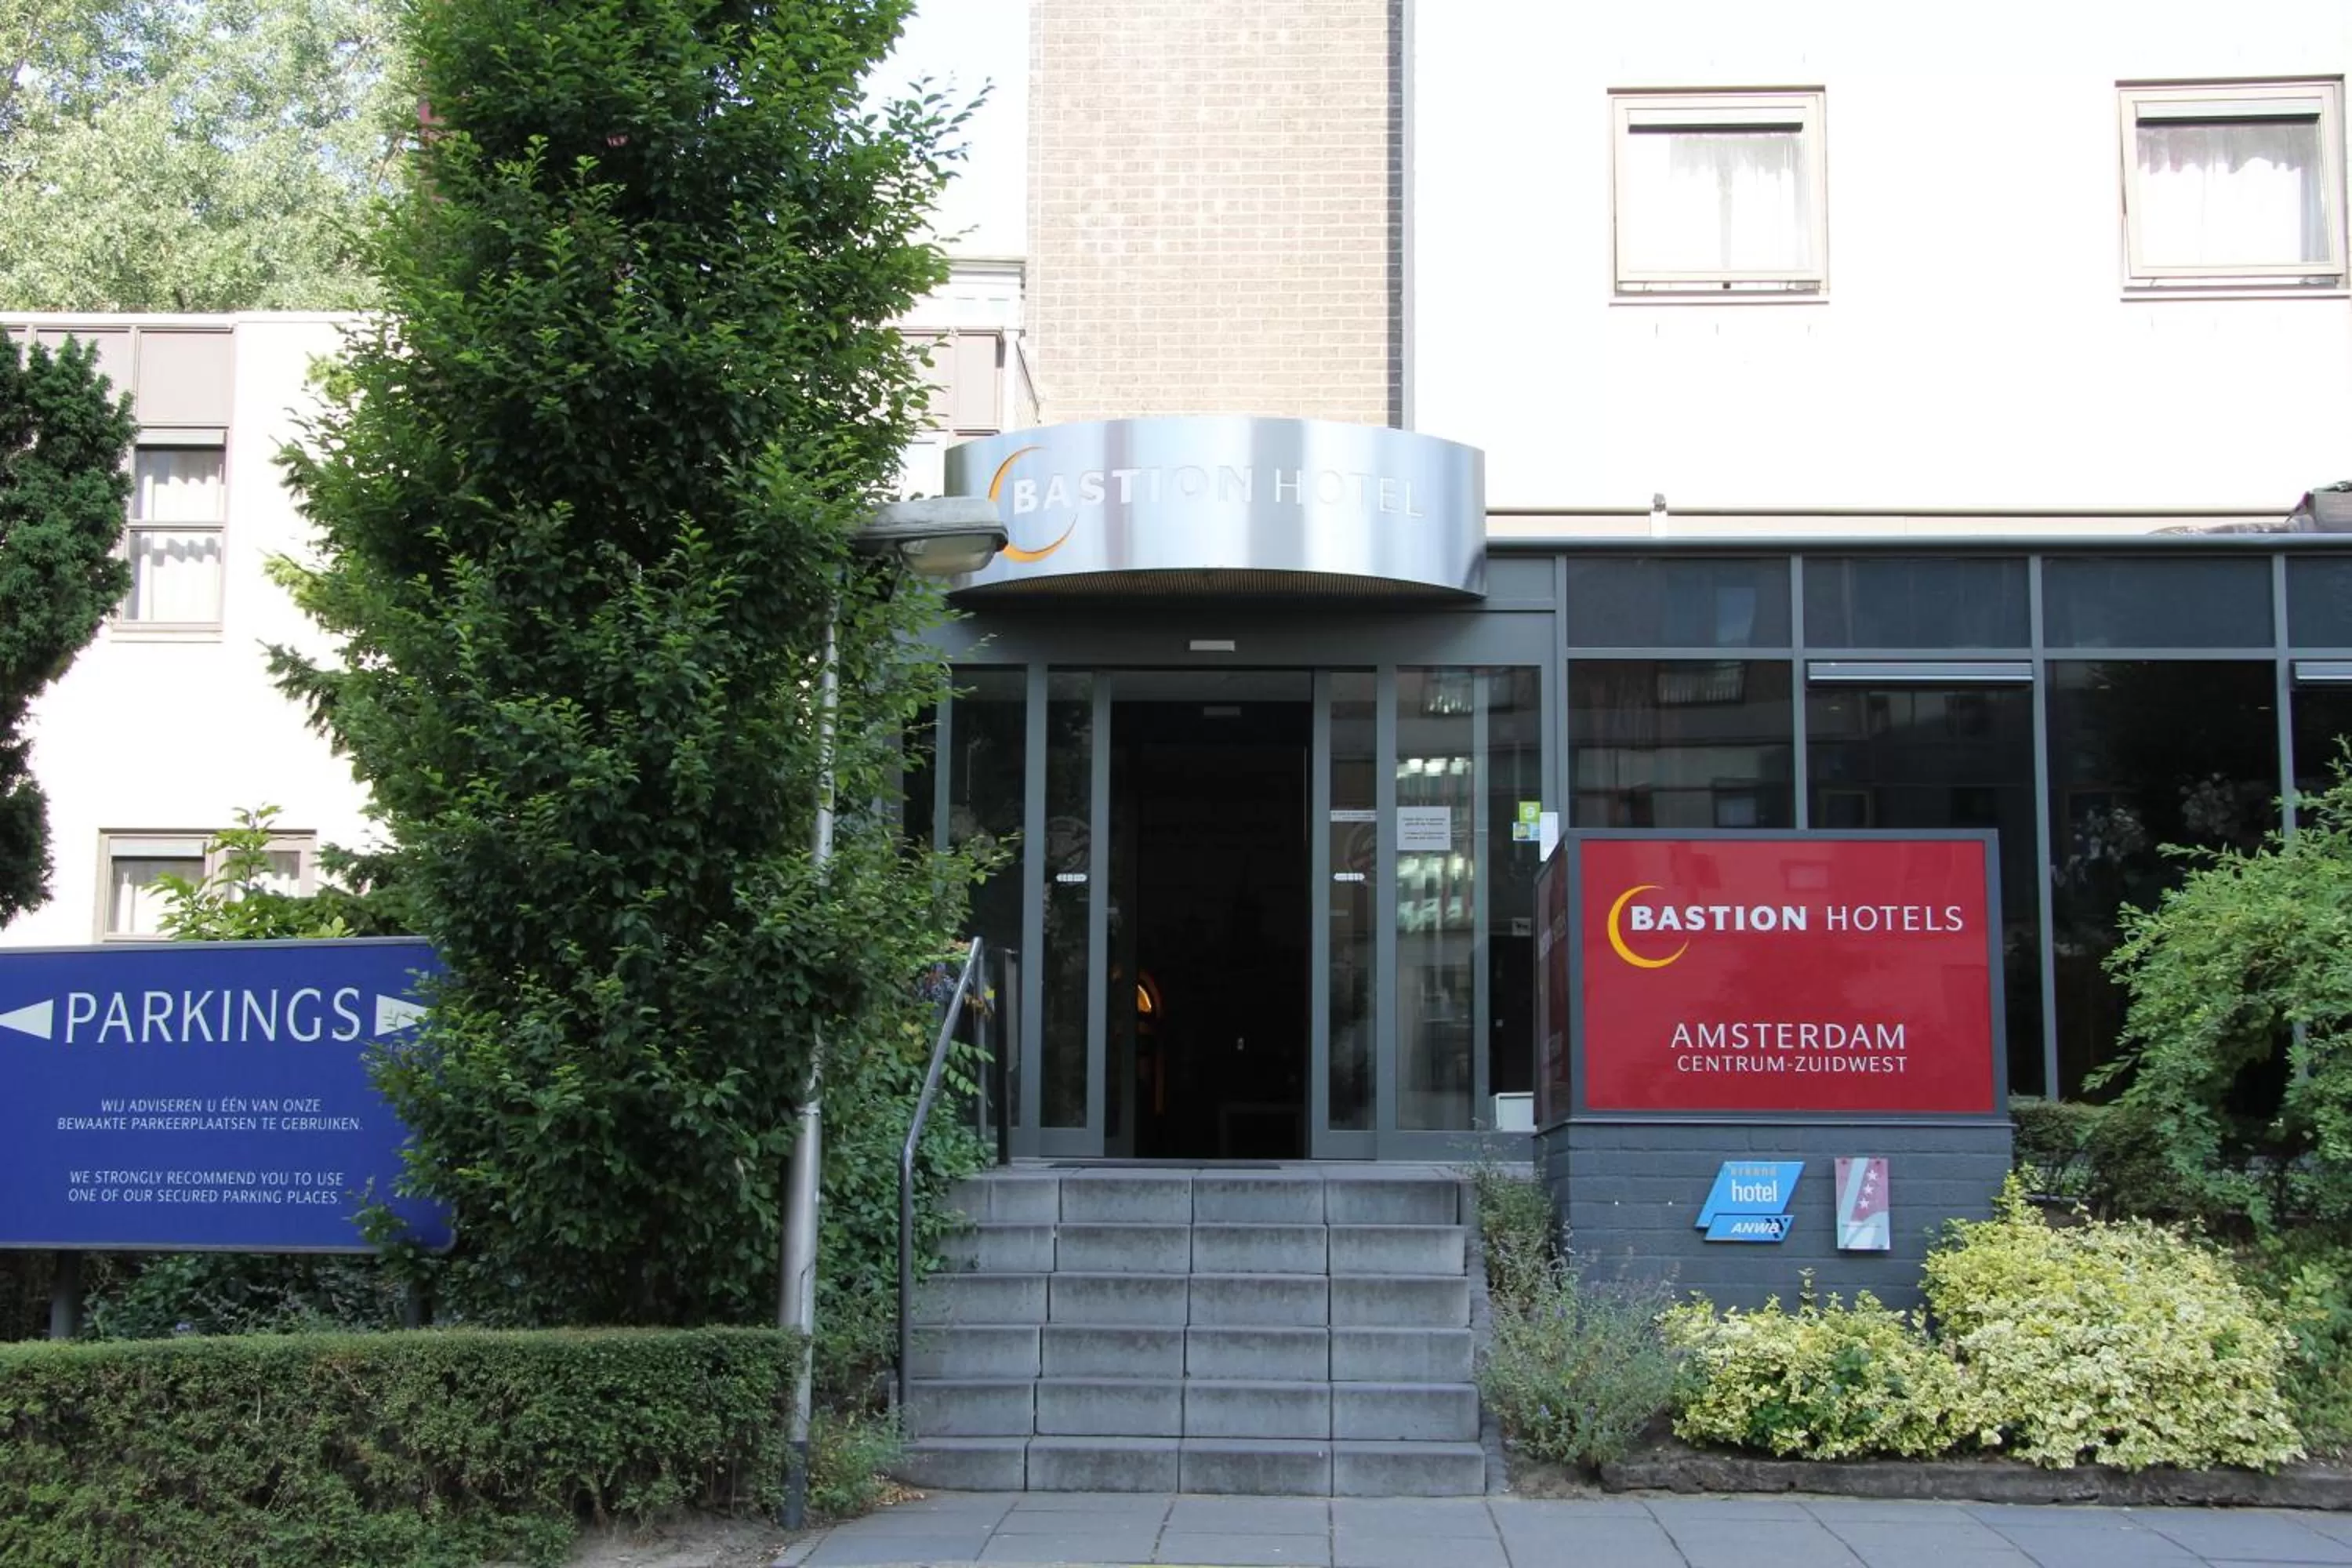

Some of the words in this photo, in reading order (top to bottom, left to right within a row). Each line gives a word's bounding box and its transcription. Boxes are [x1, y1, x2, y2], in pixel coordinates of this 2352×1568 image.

[1012, 465, 1252, 515] BASTION
[1274, 466, 1425, 519] HOTEL
[1631, 905, 1807, 931] BASTION
[1827, 906, 1964, 932] HOTELS
[65, 987, 361, 1044] PARKINGS
[1671, 1023, 1905, 1050] AMSTERDAM
[1677, 1055, 1907, 1073] CENTRUM-ZUIDWEST
[101, 1098, 125, 1112] WIJ
[128, 1098, 202, 1112] ADVISEREN
[207, 1099, 216, 1112] U
[252, 1098, 278, 1112] VAN
[283, 1098, 321, 1112] ONZE
[57, 1117, 126, 1130] BEWAAKTE
[131, 1117, 256, 1130] PARKEERPLAATSEN
[261, 1117, 277, 1130] TE
[281, 1117, 364, 1130] GEBRUIKEN.
[70, 1171, 90, 1184] WE
[95, 1171, 163, 1185] STRONGLY
[167, 1171, 256, 1185] RECOMMEND
[261, 1172, 289, 1185] YOU
[294, 1172, 312, 1186] TO
[318, 1172, 343, 1186] USE
[68, 1188, 96, 1202] ONE
[101, 1189, 119, 1202] OF
[123, 1189, 153, 1202] OUR
[158, 1189, 218, 1203] SECURED
[223, 1189, 282, 1203] PARKING
[287, 1191, 342, 1204] PLACES.
[1730, 1178, 1778, 1203] hotel
[1730, 1222, 1780, 1234] ANWB
